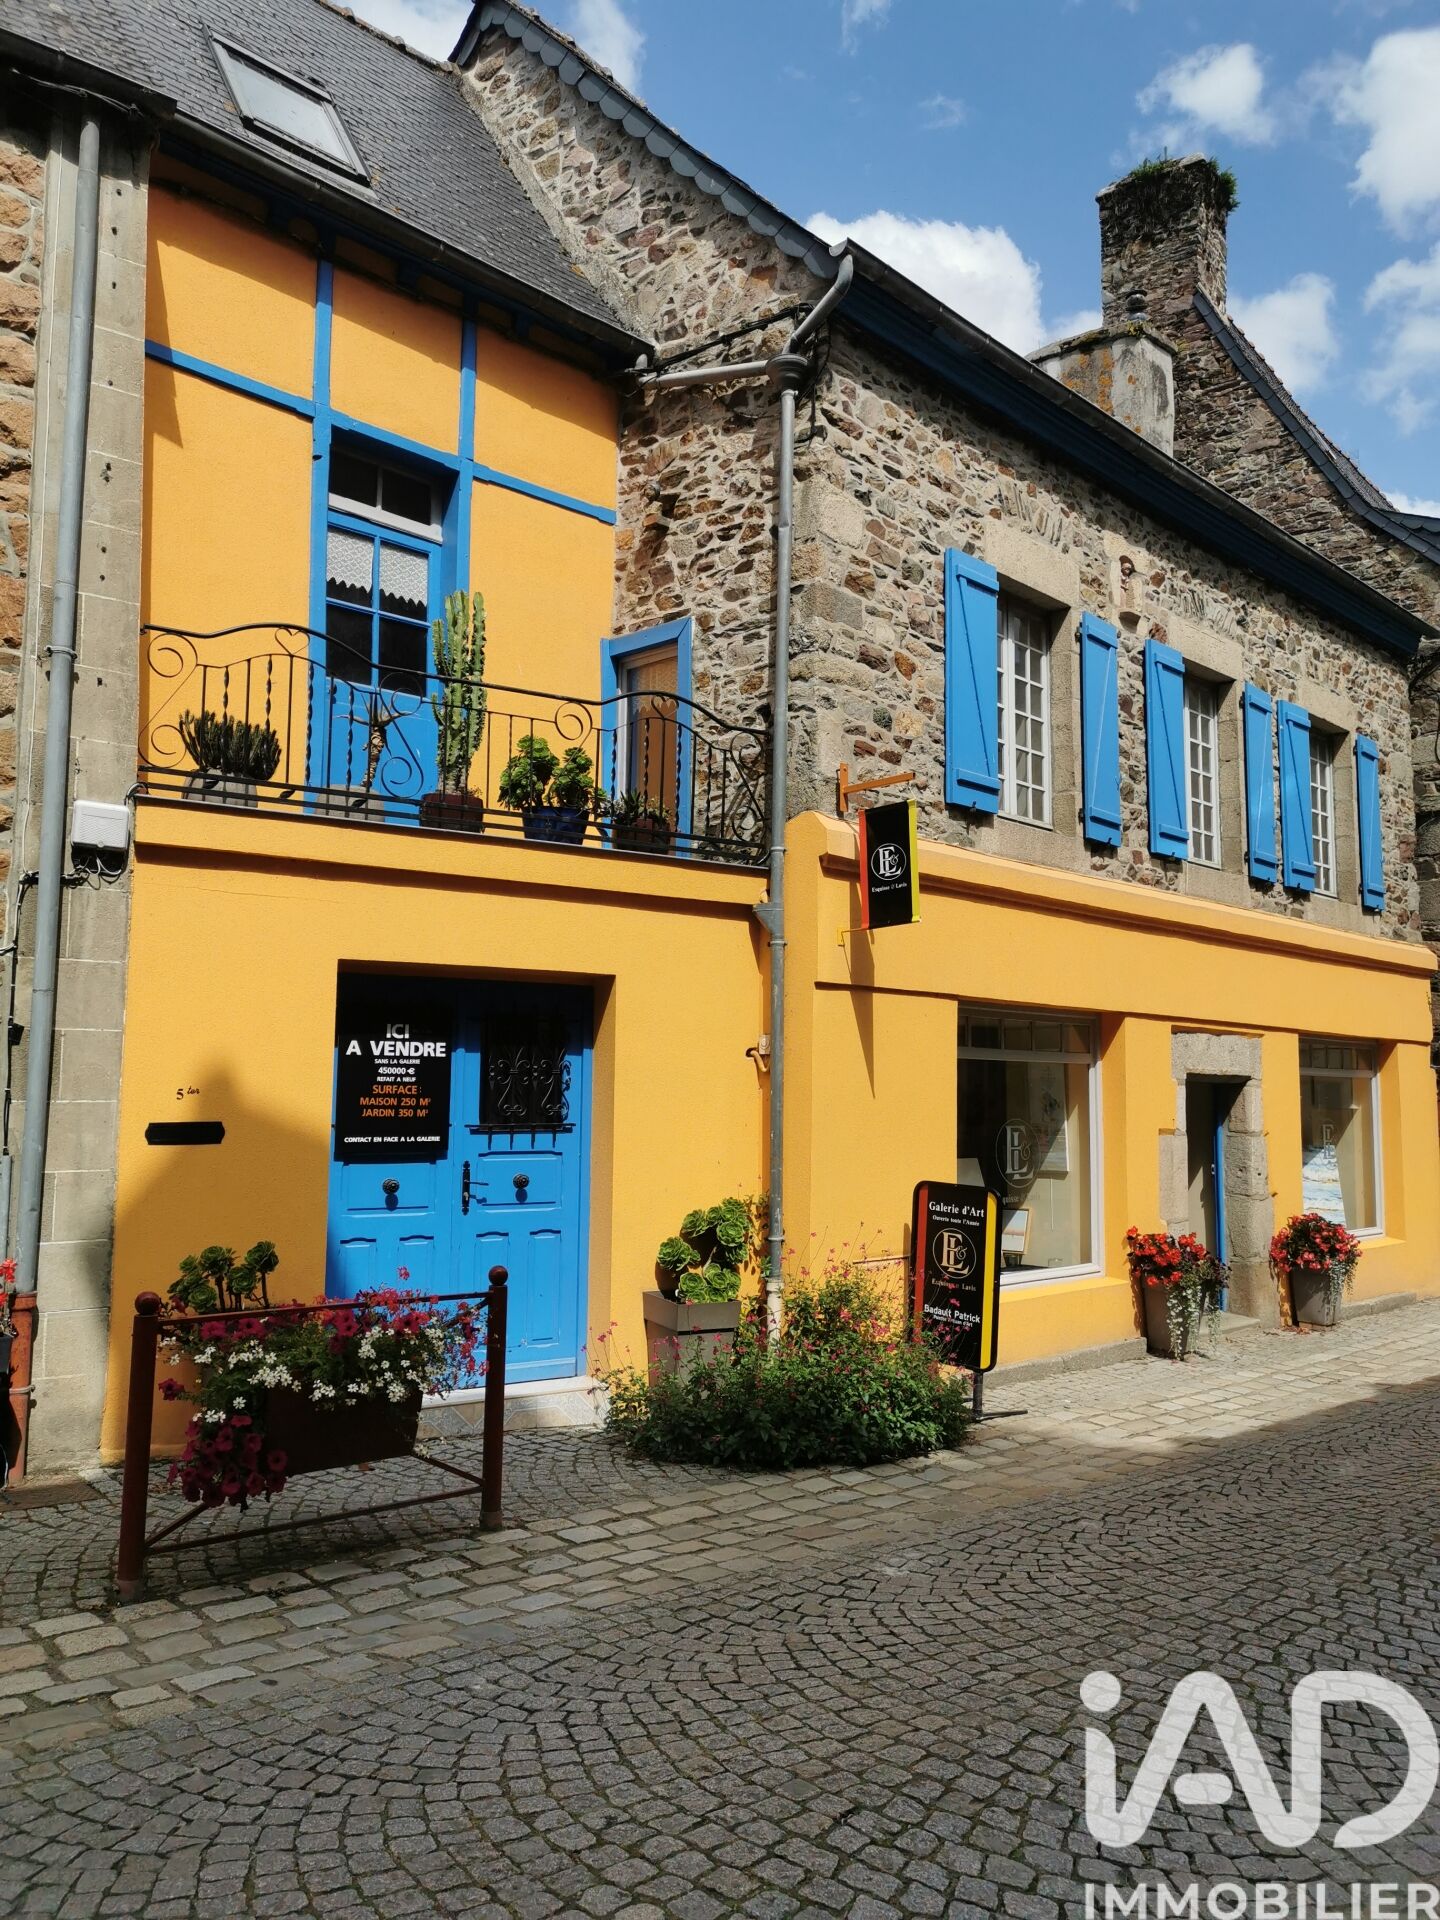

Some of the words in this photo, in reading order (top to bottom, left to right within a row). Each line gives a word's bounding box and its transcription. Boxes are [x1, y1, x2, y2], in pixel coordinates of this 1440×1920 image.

[386, 1024, 409, 1039] ICI
[345, 1040, 362, 1056] A
[369, 1040, 447, 1058] VENDRE
[378, 1066, 406, 1075] 450000
[176, 1088, 184, 1100] 5
[372, 1084, 418, 1095] SURFACE
[359, 1097, 398, 1106] MAISON
[400, 1097, 416, 1107] 250
[361, 1108, 395, 1117] JARDIN
[398, 1109, 414, 1117] 350
[929, 1201, 960, 1214] Galerie
[961, 1205, 985, 1218] d'Art
[924, 1304, 952, 1318] Badault
[954, 1310, 980, 1323] Patrick
